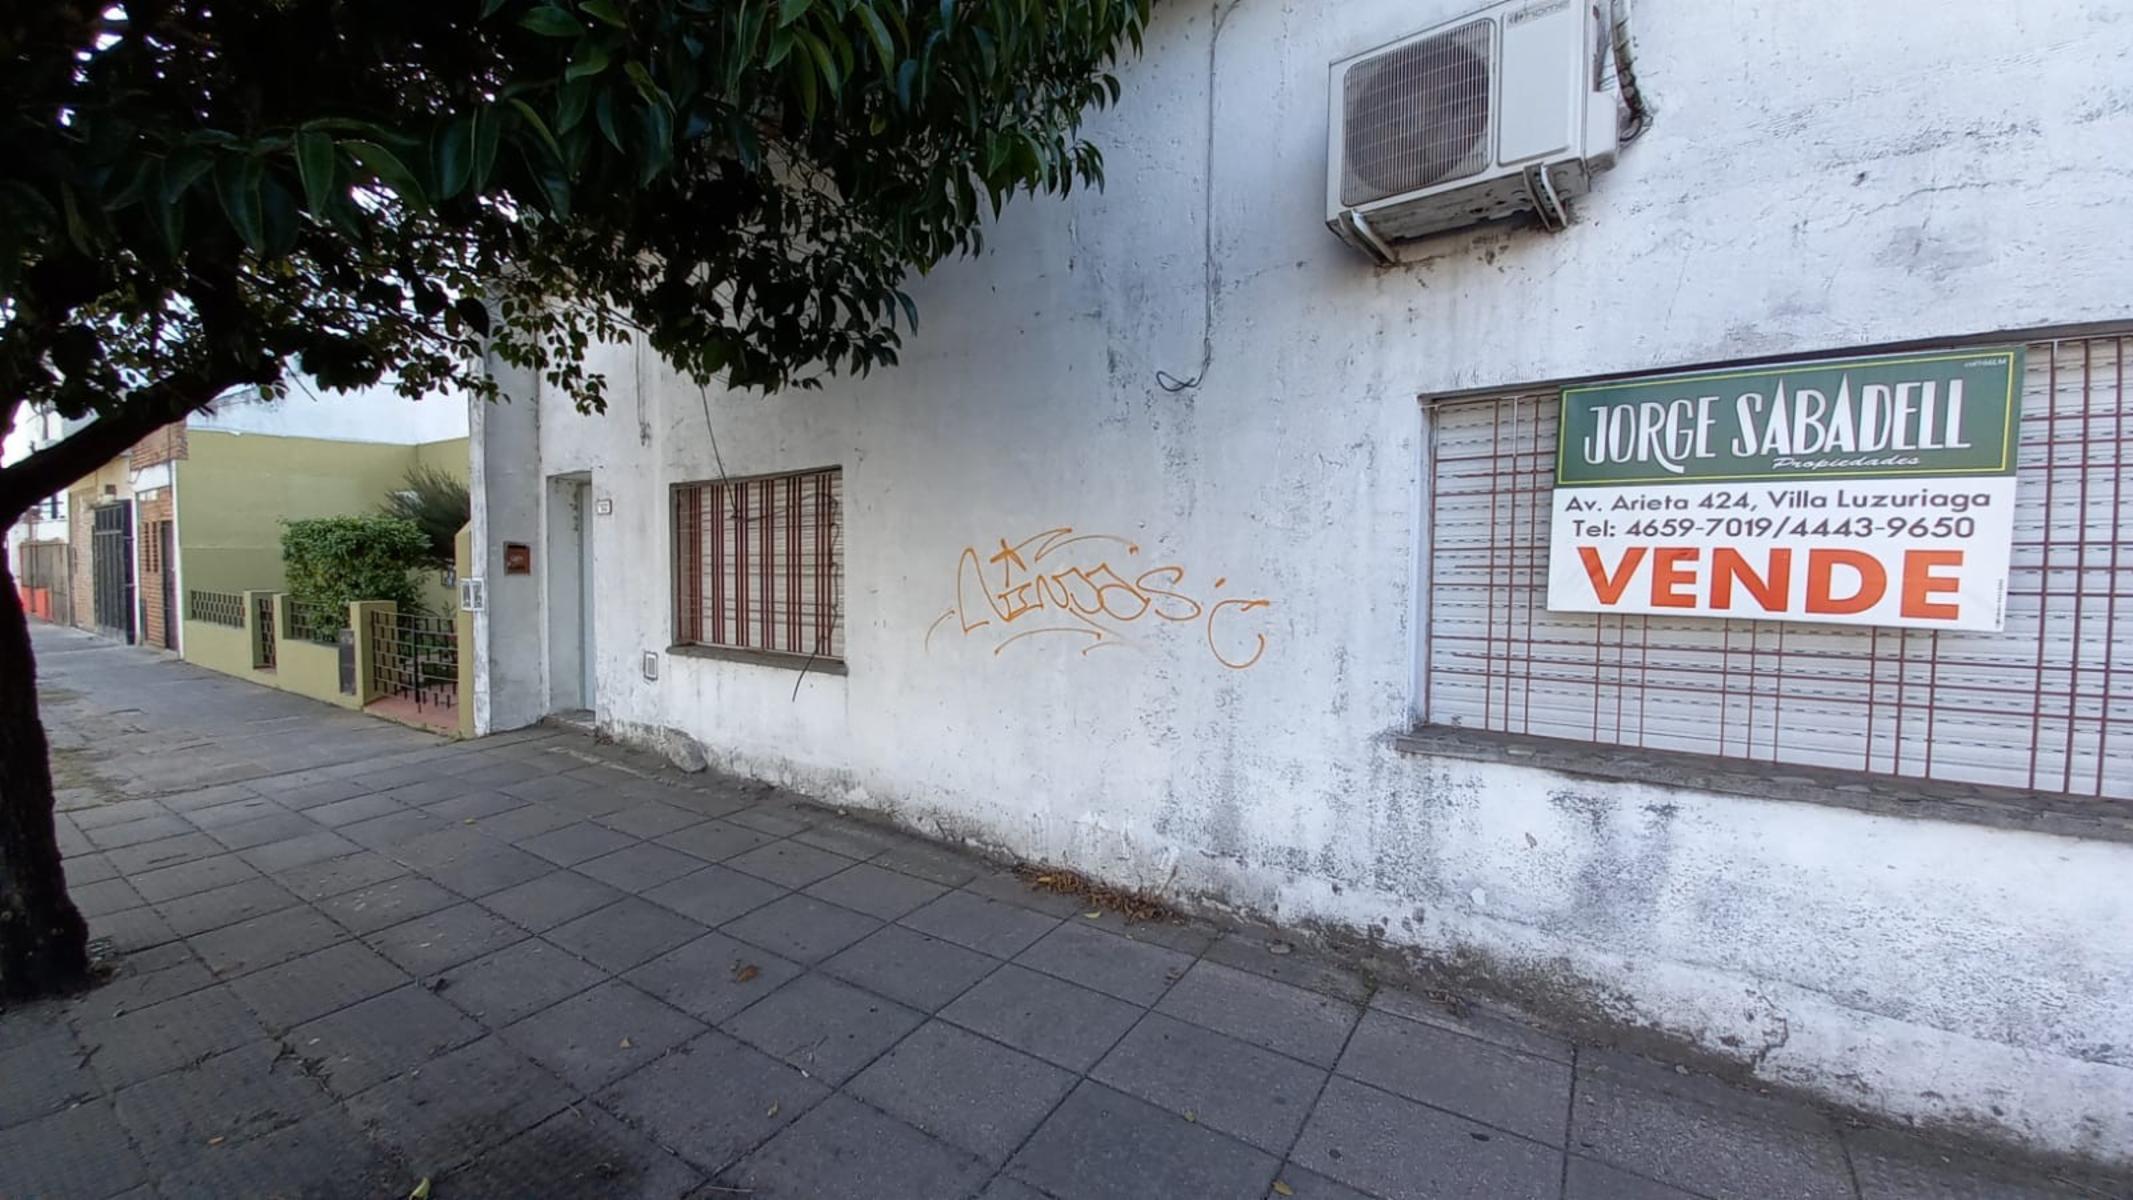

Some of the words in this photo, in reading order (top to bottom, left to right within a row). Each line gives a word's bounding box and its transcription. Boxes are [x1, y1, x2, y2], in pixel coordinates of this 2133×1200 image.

[1584, 396, 1720, 474] JORGE
[1732, 373, 1971, 457] SABADELL
[1772, 454, 1920, 470] Propiedades
[1565, 496, 1602, 512] Av.
[1611, 495, 1689, 511] Arieta
[1698, 491, 1758, 512] 424,
[1768, 490, 1827, 508] Villa
[1838, 488, 1991, 513] Luzuriaga
[1573, 520, 1616, 537] Tel:
[1626, 516, 1975, 539] 4659-7019/4443-9650
[1577, 546, 1964, 620] VENDE
